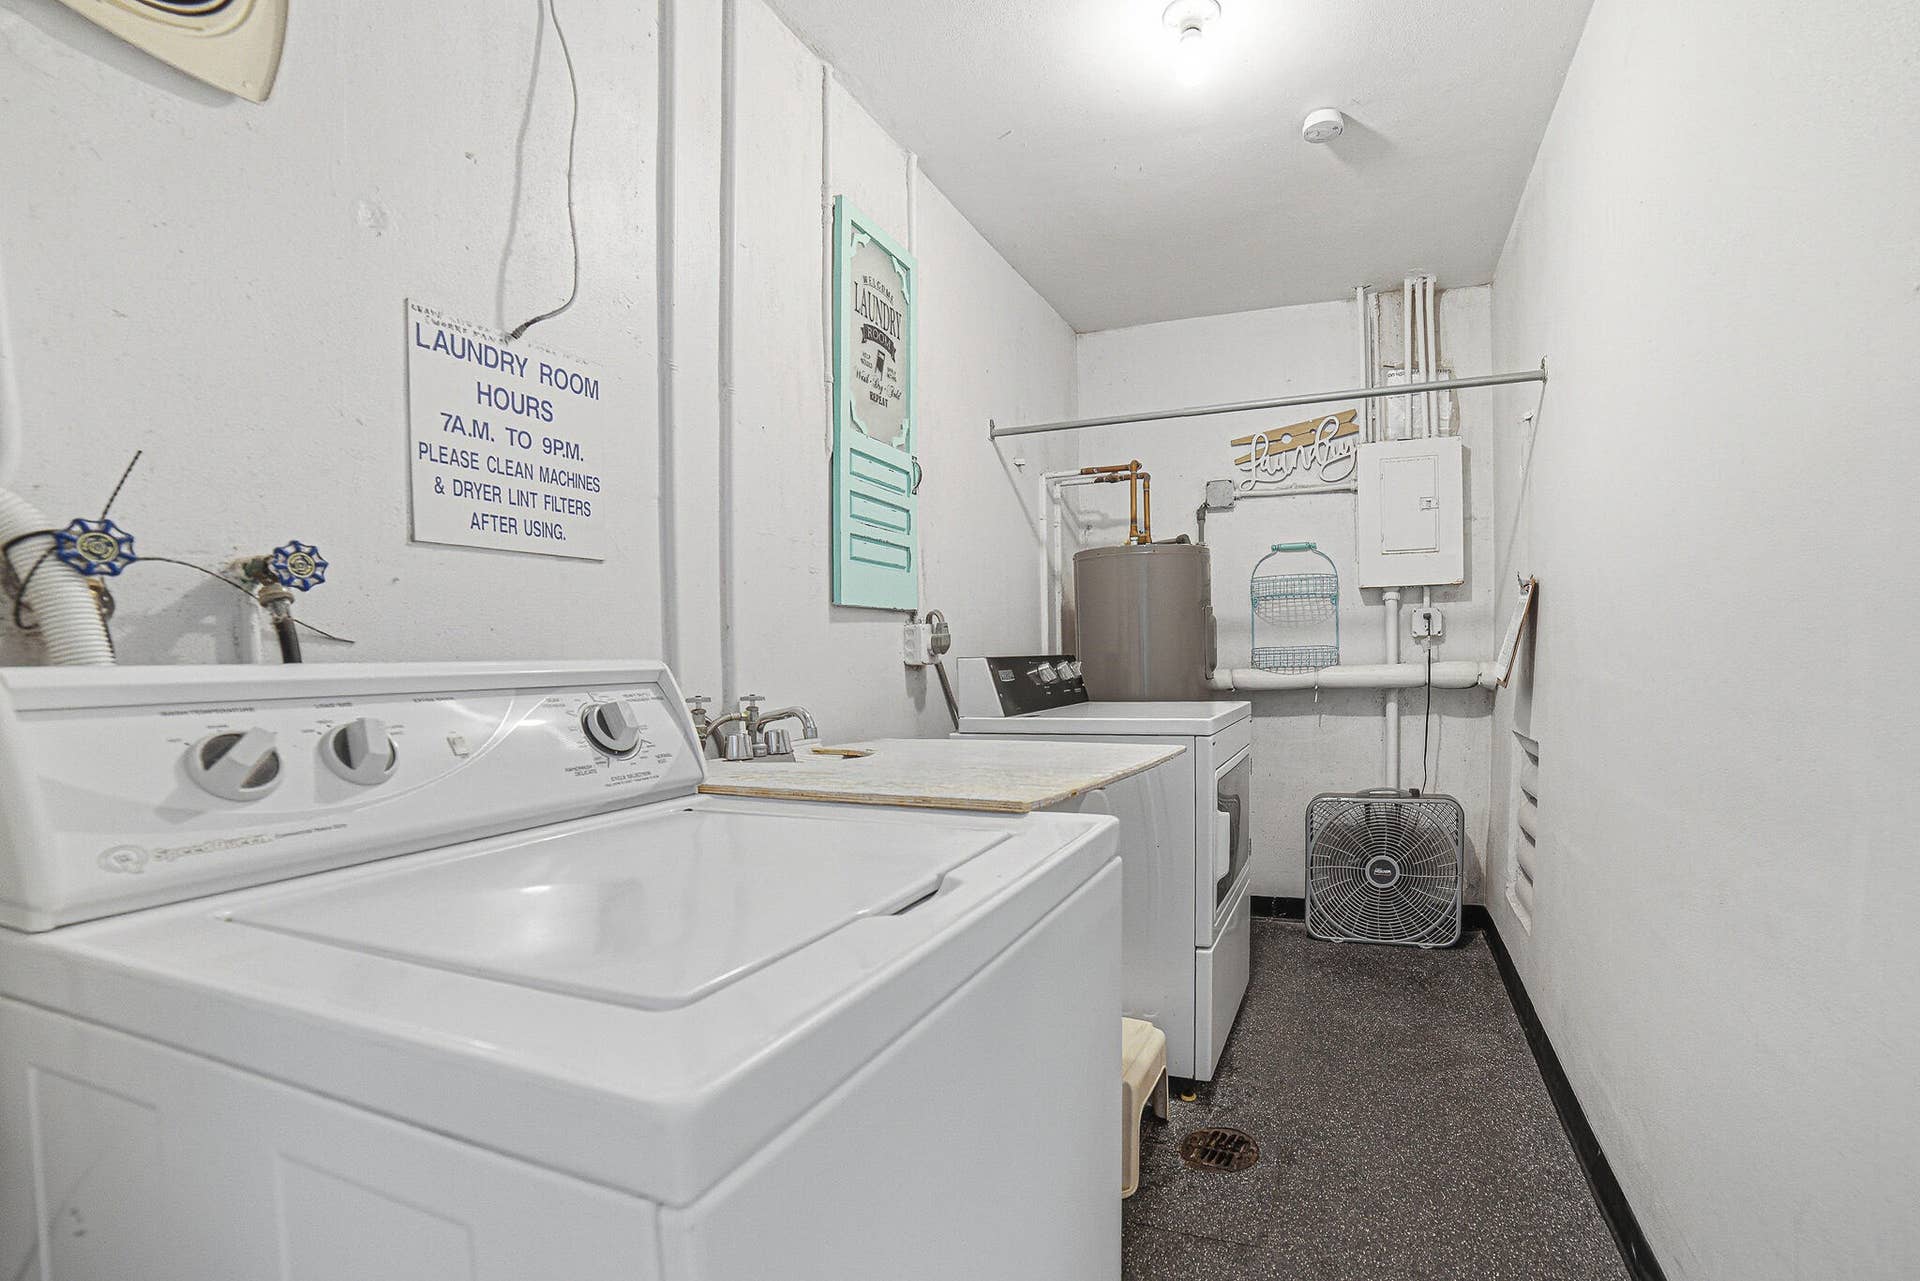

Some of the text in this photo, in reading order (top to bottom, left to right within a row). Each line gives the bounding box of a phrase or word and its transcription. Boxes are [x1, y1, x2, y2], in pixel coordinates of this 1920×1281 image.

[862, 275, 895, 302] WELCOME
[854, 281, 902, 341] LAUNDRY
[867, 328, 892, 350] ROOM
[415, 322, 528, 377] LAUNDRY
[540, 362, 600, 400] ROOM
[476, 381, 554, 423] HOURS
[869, 390, 888, 408] REPEAT
[440, 412, 584, 462] 7A.M. TO 9P.M.
[418, 441, 601, 493] PLEASE CLEAN MACHINES
[434, 476, 592, 517] & DRYER LINT FILTERS
[470, 512, 567, 541] AFTER USING.
